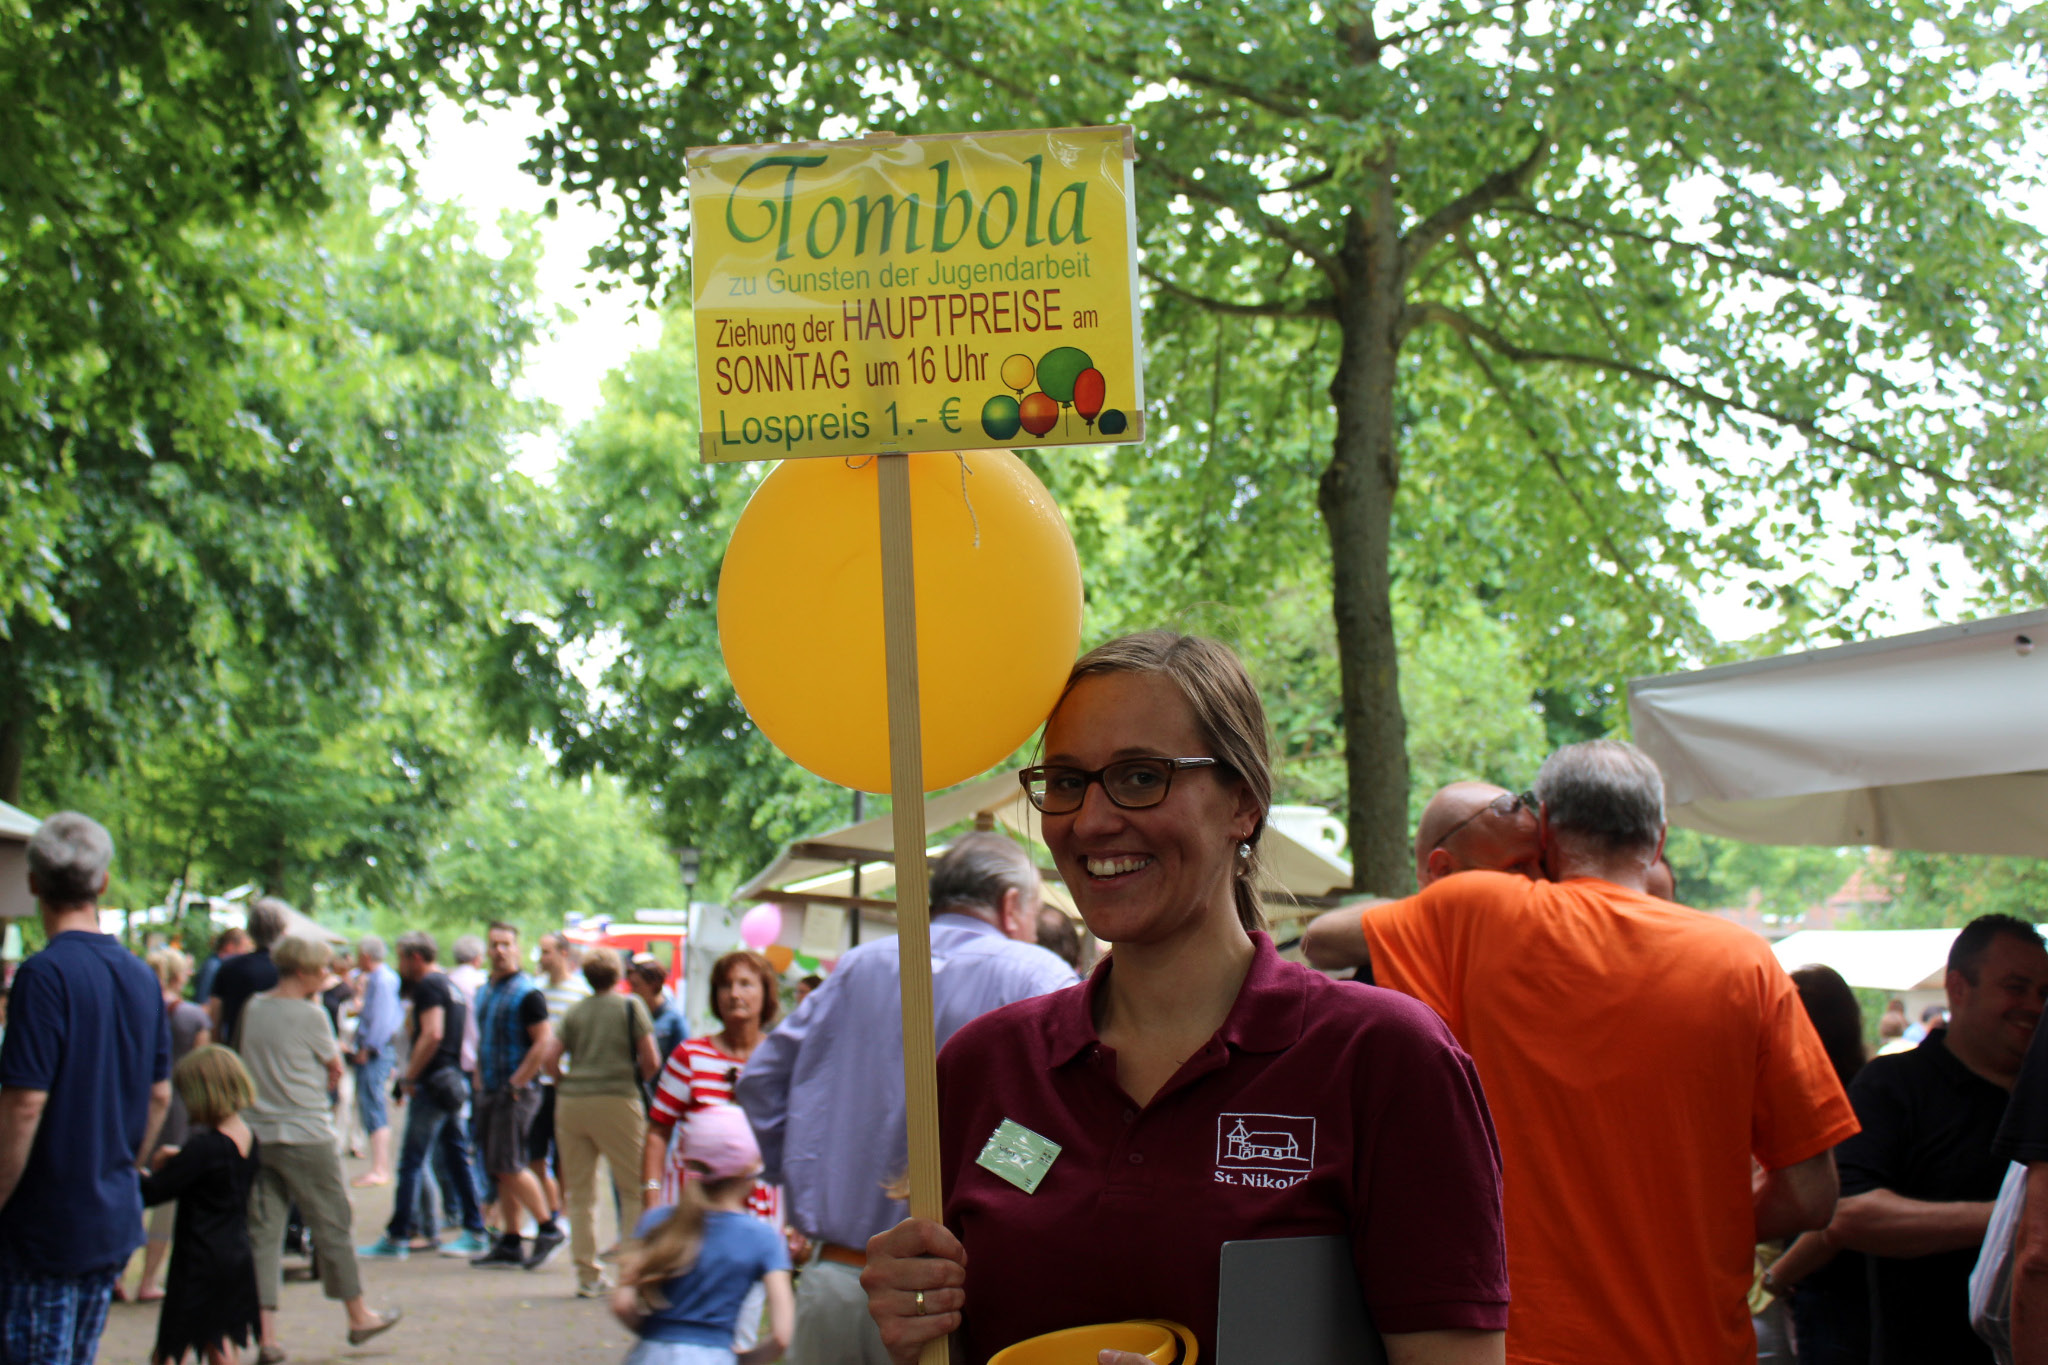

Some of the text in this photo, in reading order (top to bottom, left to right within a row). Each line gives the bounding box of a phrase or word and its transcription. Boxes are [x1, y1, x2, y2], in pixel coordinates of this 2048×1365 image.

[725, 153, 1093, 262] Tombola
[728, 252, 1091, 296] zu Gunsten der Jugendarbeit
[715, 289, 1099, 351] Ziehung der HAUPTPREISE am
[716, 343, 990, 395] SONNTAG um 16 Uhr
[720, 403, 870, 451] Lospreis
[939, 396, 963, 434] €
[1214, 1170, 1309, 1190] St. Nikol
